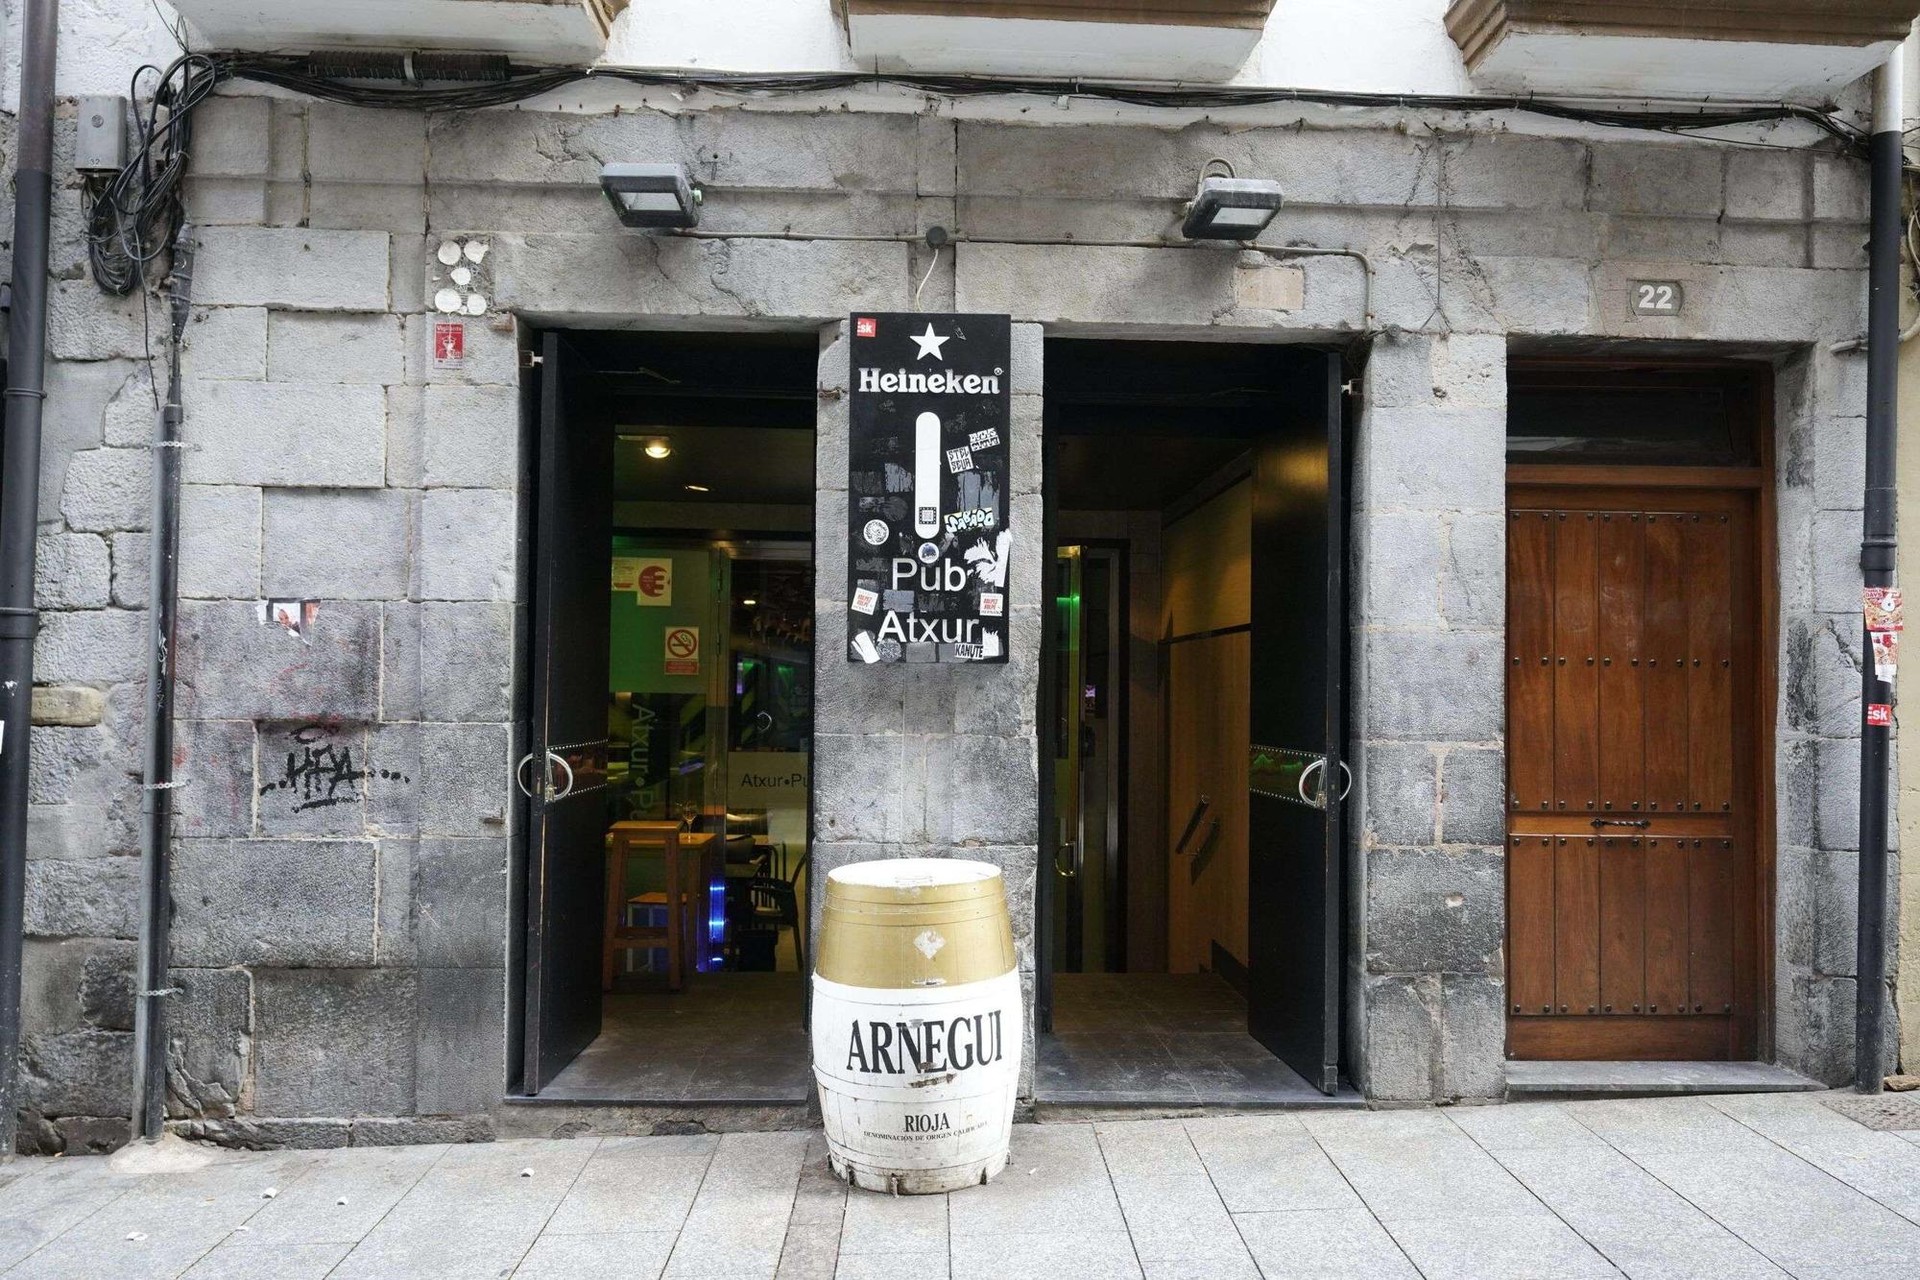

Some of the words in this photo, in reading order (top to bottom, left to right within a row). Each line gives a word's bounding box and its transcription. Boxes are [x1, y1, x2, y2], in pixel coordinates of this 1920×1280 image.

[1638, 284, 1673, 309] 22
[892, 558, 967, 592] Pub
[877, 610, 979, 643] Atxur
[955, 644, 983, 658] KANUTE
[846, 1010, 1002, 1075] ARNEGUI
[905, 1113, 950, 1132] RIOJA
[915, 1134, 925, 1142] DE
[926, 1131, 952, 1141] ORIGEN
